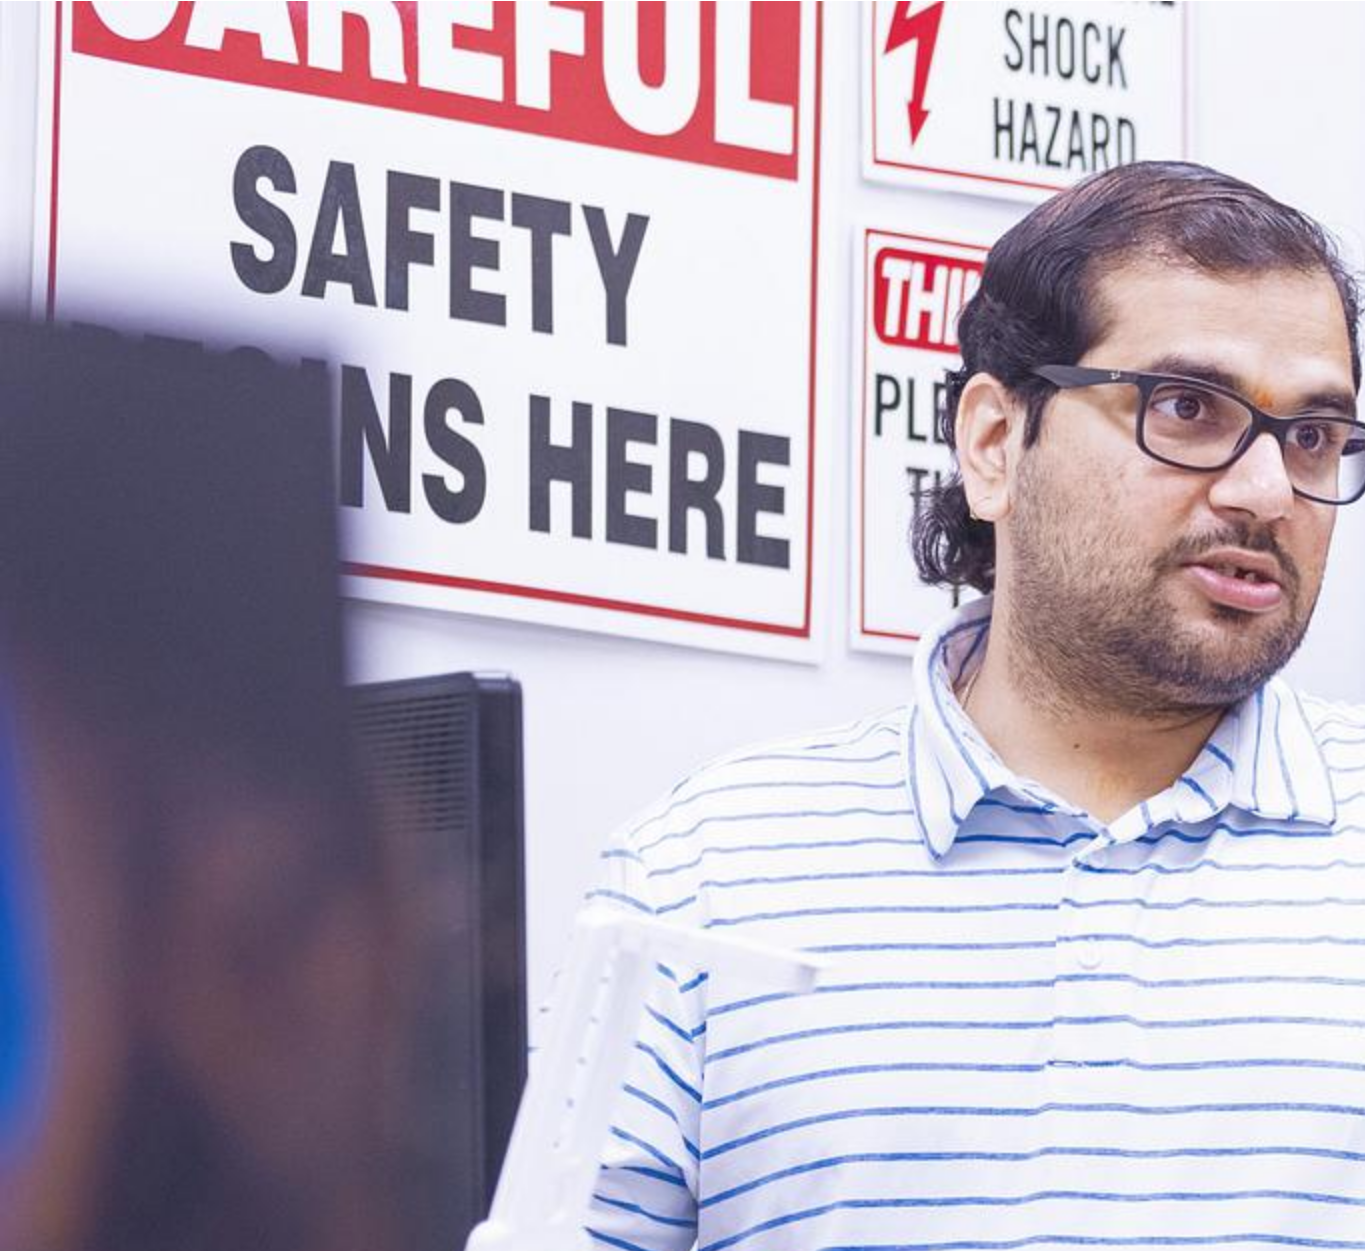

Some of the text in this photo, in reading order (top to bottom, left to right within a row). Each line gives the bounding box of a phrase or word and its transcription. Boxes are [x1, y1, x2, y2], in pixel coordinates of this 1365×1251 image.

[1003, 8, 1128, 90] SHOCK
[992, 96, 1137, 172] HAZARD
[228, 143, 652, 350] SAFETY
[880, 255, 982, 347] THI
[527, 393, 792, 571] HERE
